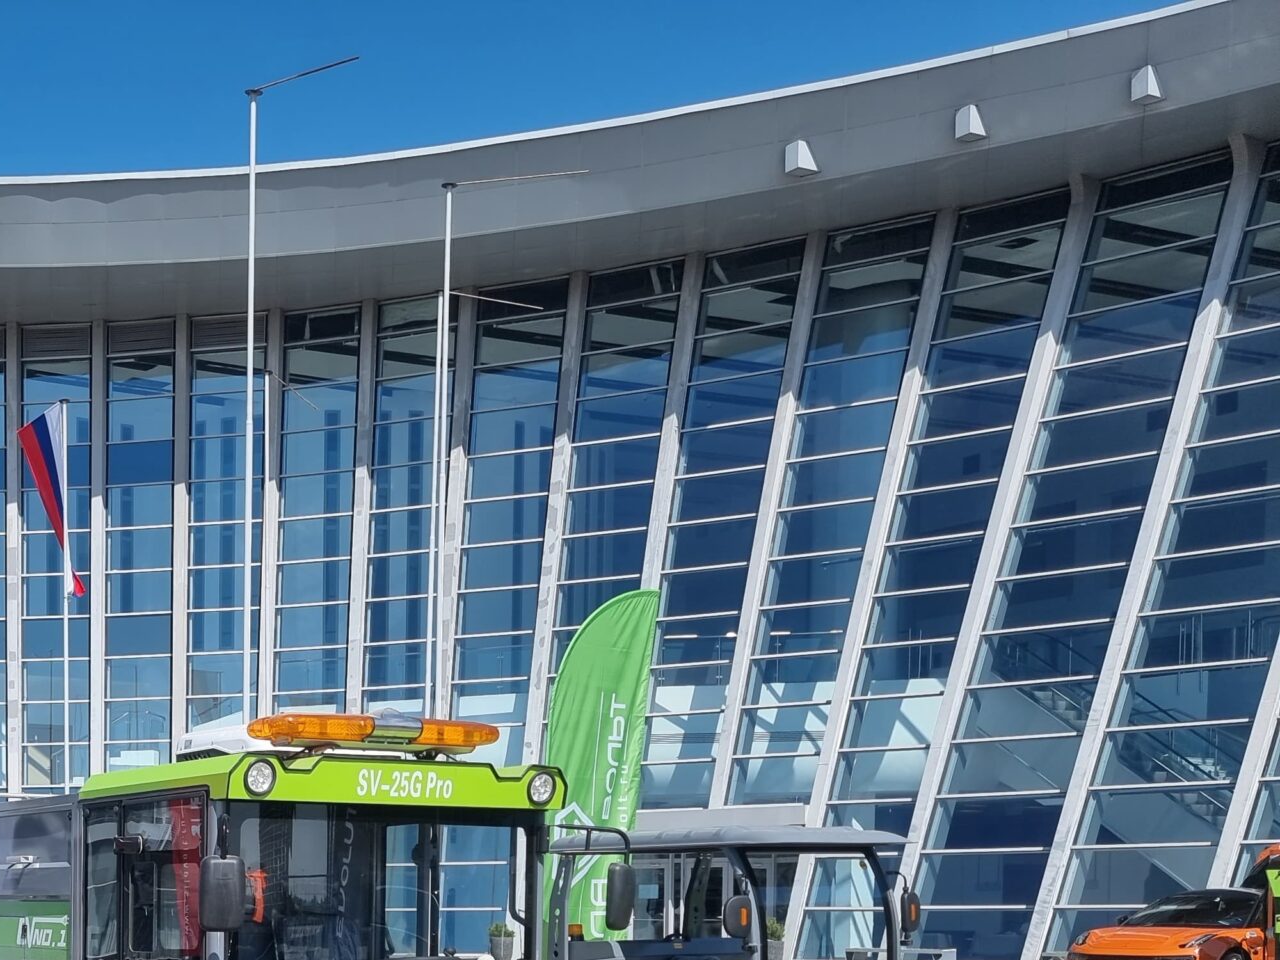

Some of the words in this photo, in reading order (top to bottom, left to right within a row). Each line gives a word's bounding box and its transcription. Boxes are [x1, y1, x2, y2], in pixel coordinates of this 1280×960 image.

[356, 768, 423, 798] SV-25G
[425, 771, 453, 799] Pro
[602, 693, 627, 820] ВОЛЬТ
